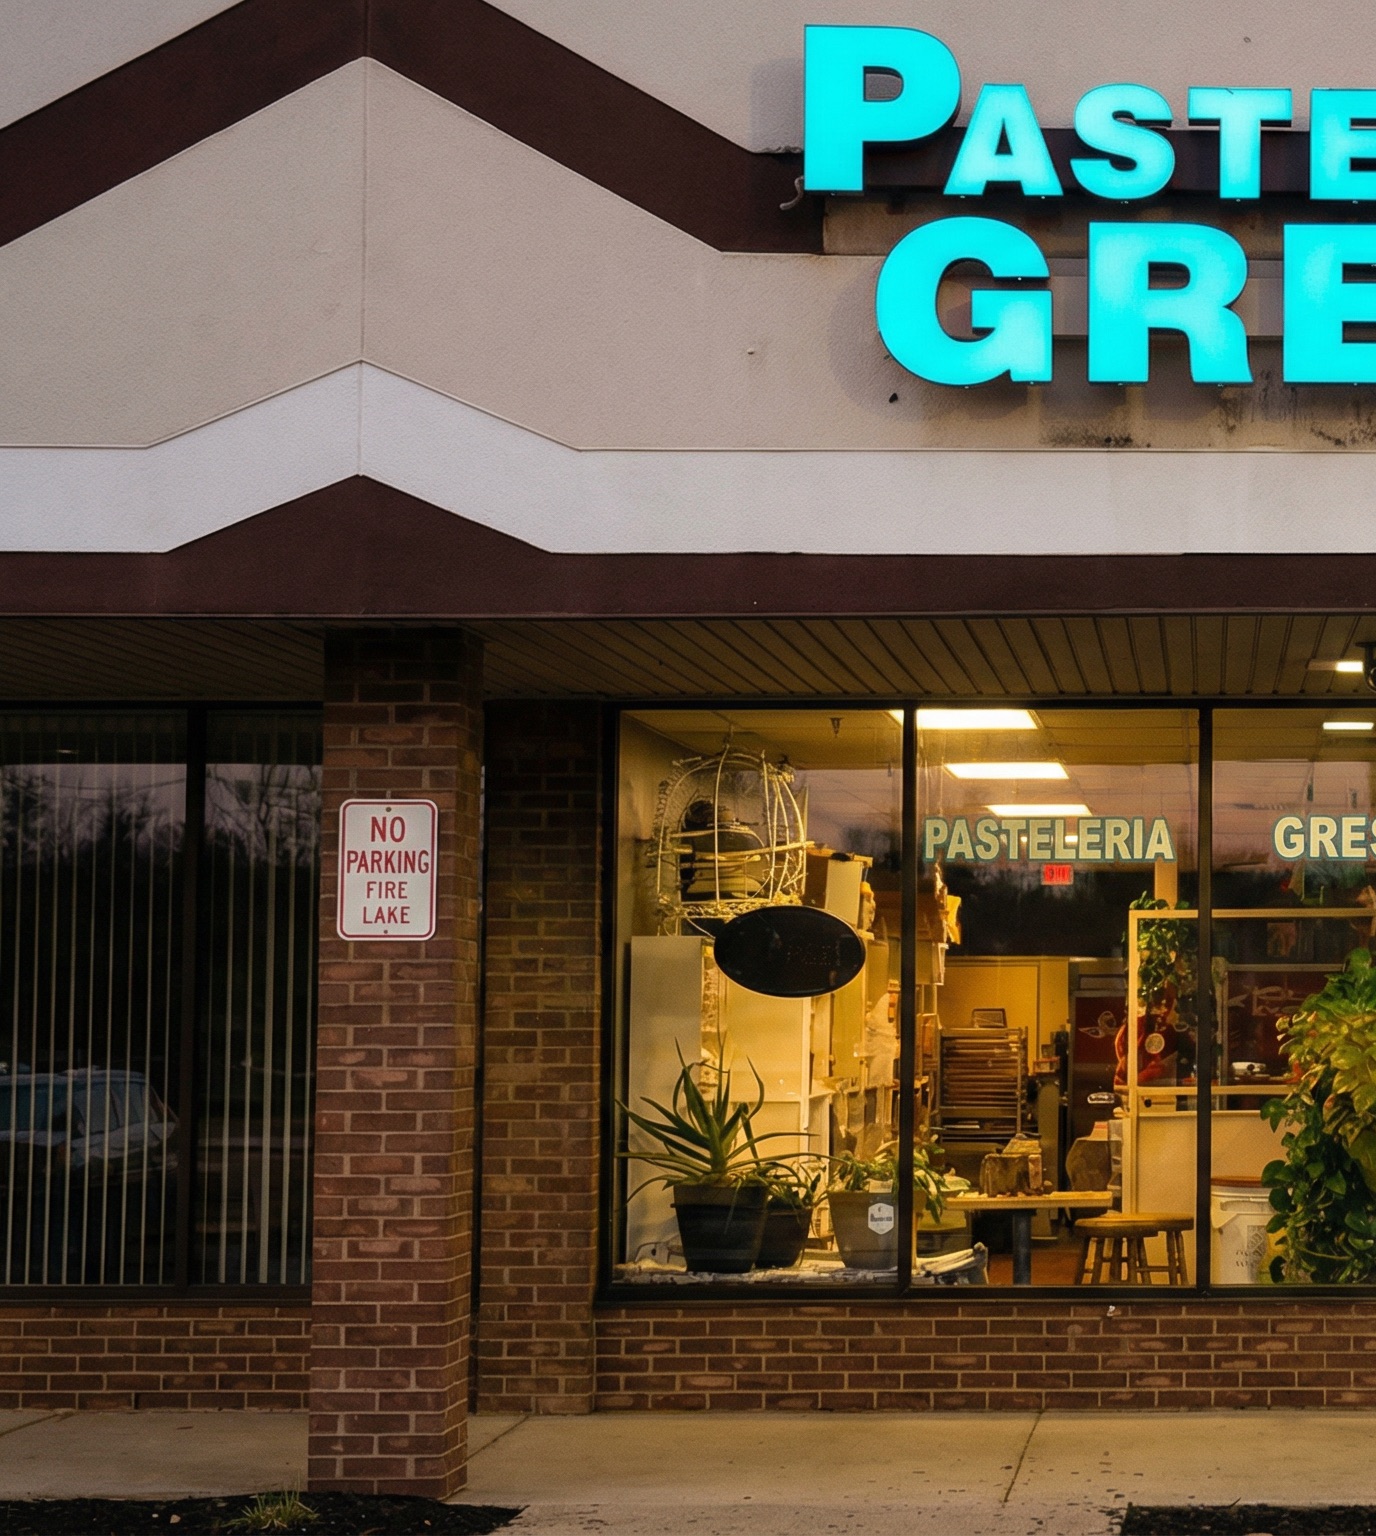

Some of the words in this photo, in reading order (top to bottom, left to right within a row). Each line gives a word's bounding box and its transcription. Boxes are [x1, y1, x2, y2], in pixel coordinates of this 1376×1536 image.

[370, 816, 406, 843] NO
[924, 818, 1176, 861] PASTELERIA
[346, 850, 430, 874] PARKING
[366, 881, 408, 899] FIRE
[362, 906, 410, 924] LAKE
